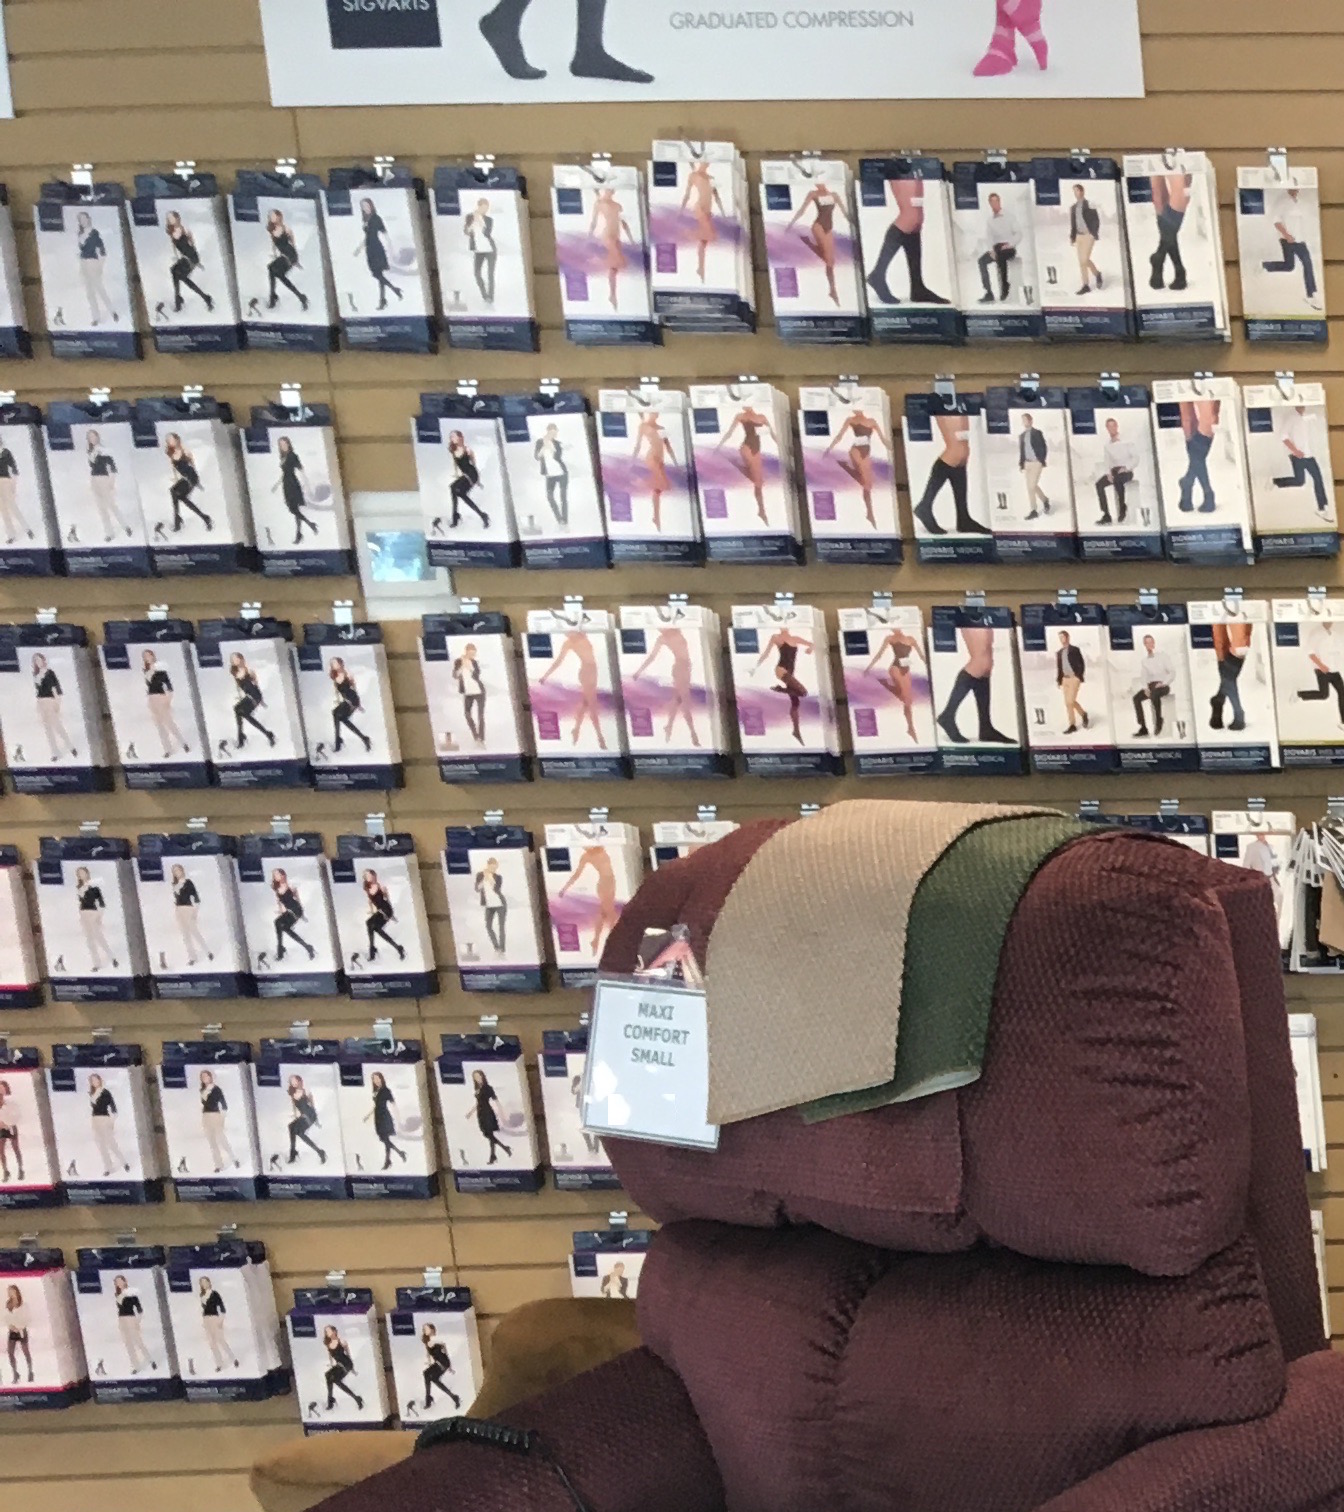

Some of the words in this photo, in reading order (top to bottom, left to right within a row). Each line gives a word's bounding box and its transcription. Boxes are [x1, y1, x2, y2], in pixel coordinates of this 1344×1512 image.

[669, 12, 778, 29] GRADUATED
[783, 10, 914, 28] COMPRESSION
[638, 1003, 675, 1021] MAXI
[623, 1023, 691, 1045] COMFORT
[631, 1047, 676, 1067] SMALL
